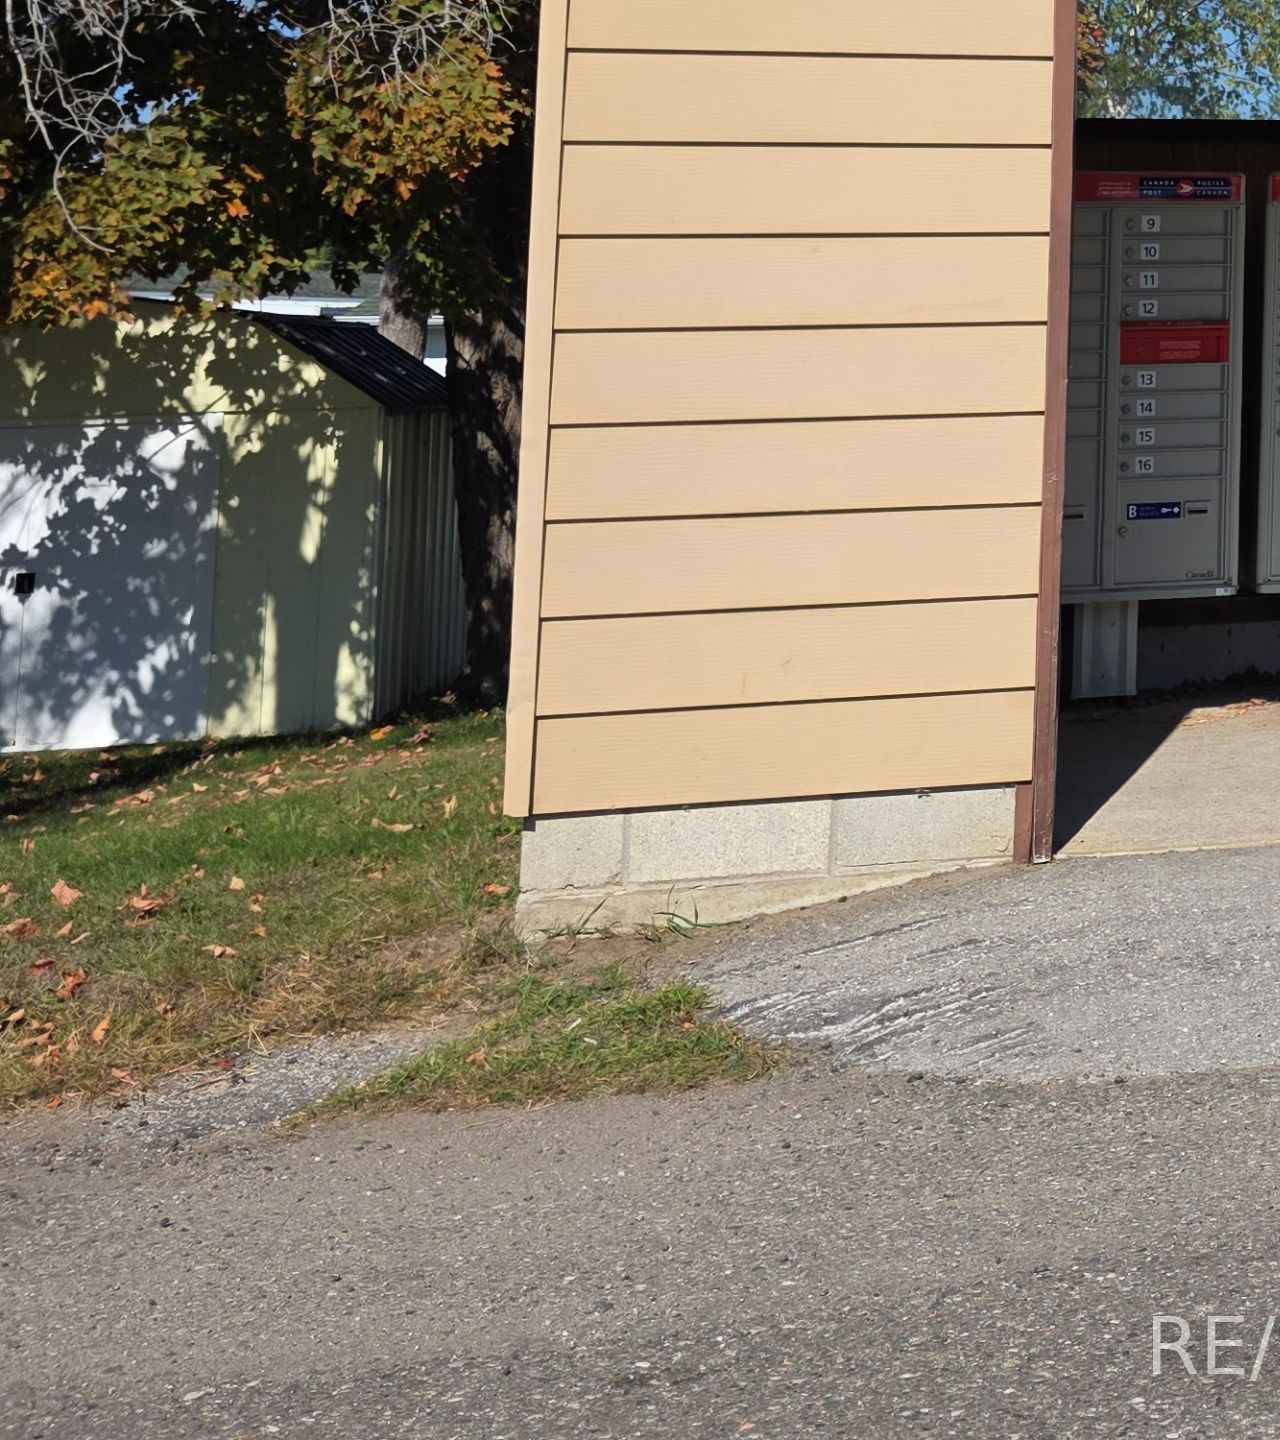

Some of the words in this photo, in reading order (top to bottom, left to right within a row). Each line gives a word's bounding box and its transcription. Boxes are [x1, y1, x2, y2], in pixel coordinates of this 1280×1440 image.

[1146, 218, 1156, 230] 9
[1143, 246, 1157, 258] 10
[1143, 274, 1155, 286] 11
[1142, 302, 1155, 314] 12
[1140, 373, 1154, 386] 13
[1140, 402, 1153, 413] 14
[1139, 430, 1153, 442] 15
[1138, 459, 1152, 471] 16
[1128, 506, 1137, 518] B
